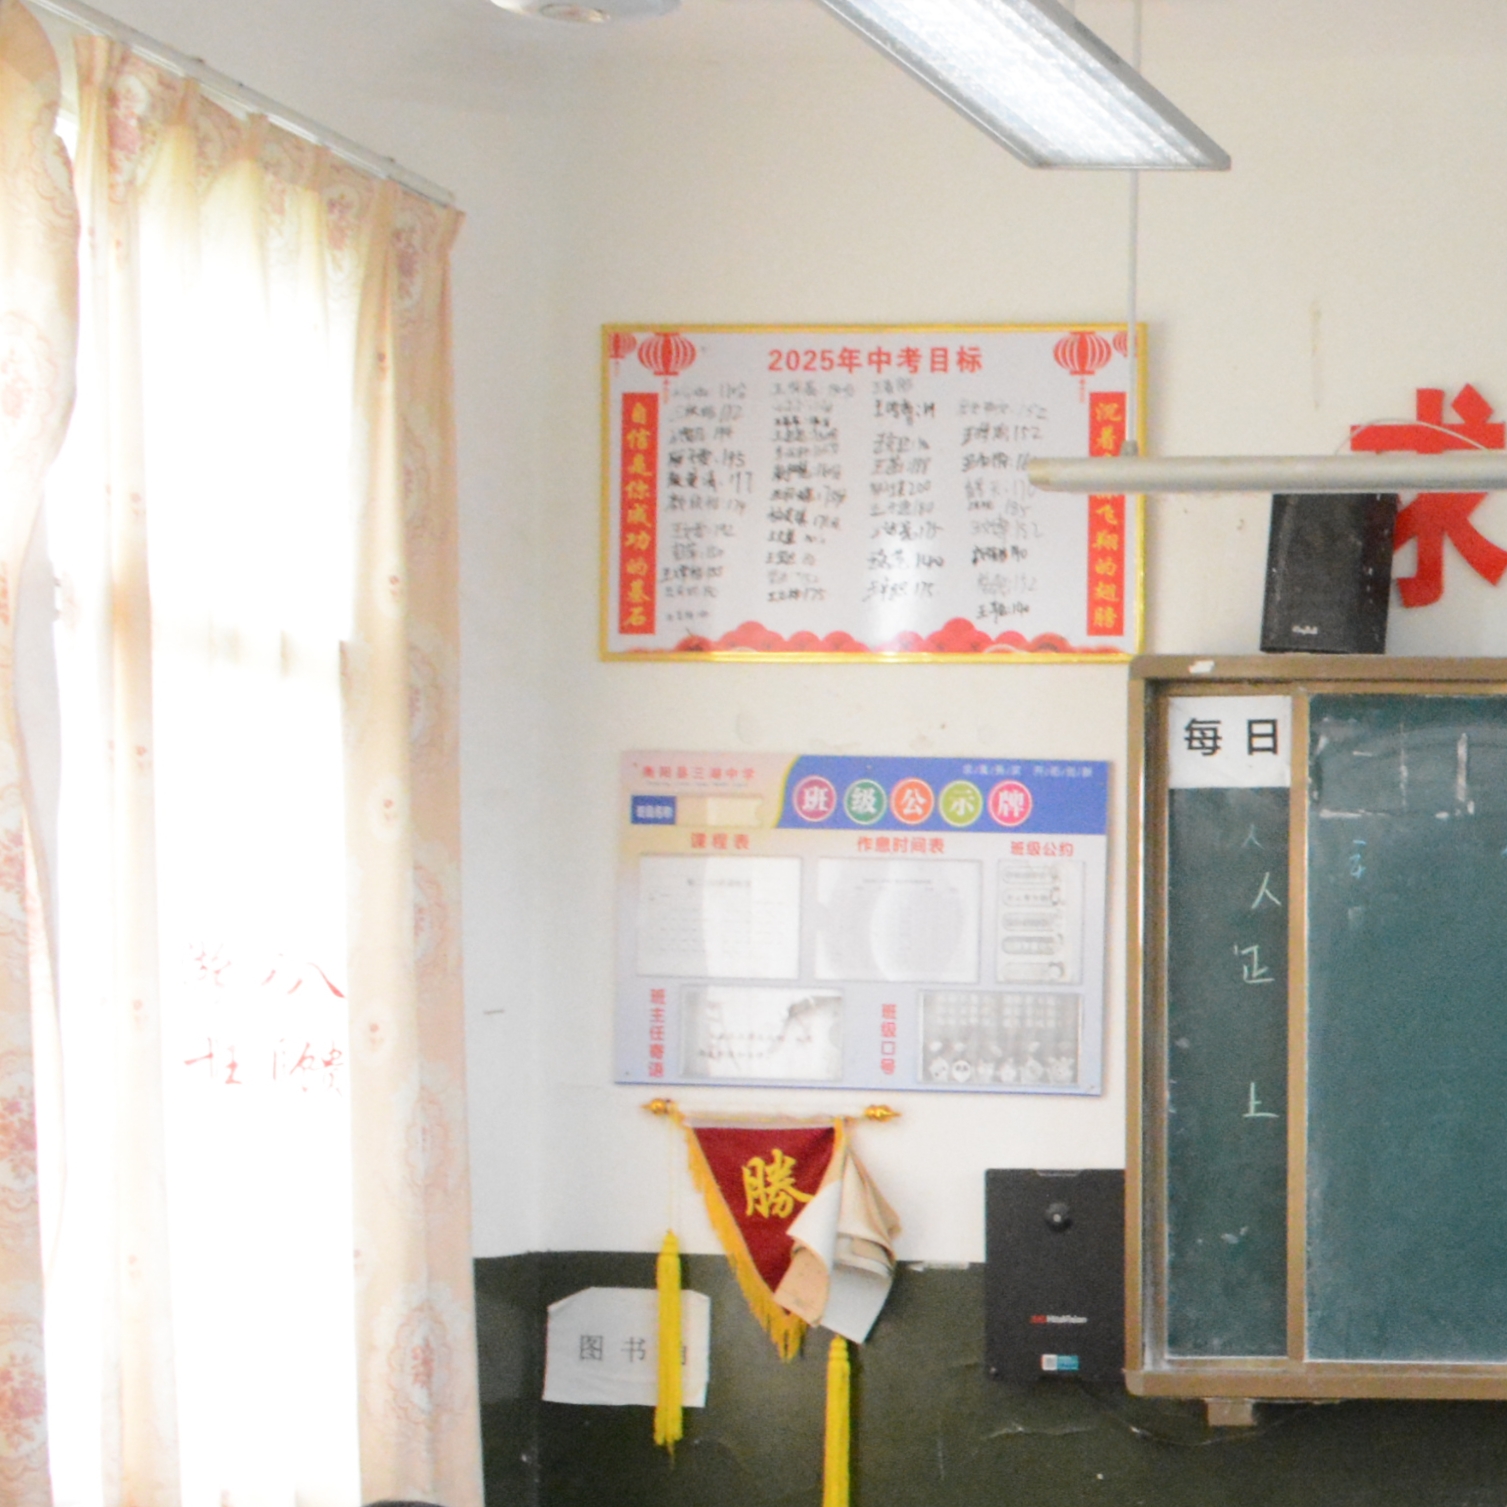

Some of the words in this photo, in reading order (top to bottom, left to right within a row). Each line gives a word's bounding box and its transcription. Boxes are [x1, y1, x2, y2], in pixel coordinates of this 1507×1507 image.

[767, 346, 984, 375] 2025年中考目标
[1184, 718, 1279, 756] 每日
[798, 785, 1025, 818] 班级公示牌
[857, 835, 946, 855] 作息时间表
